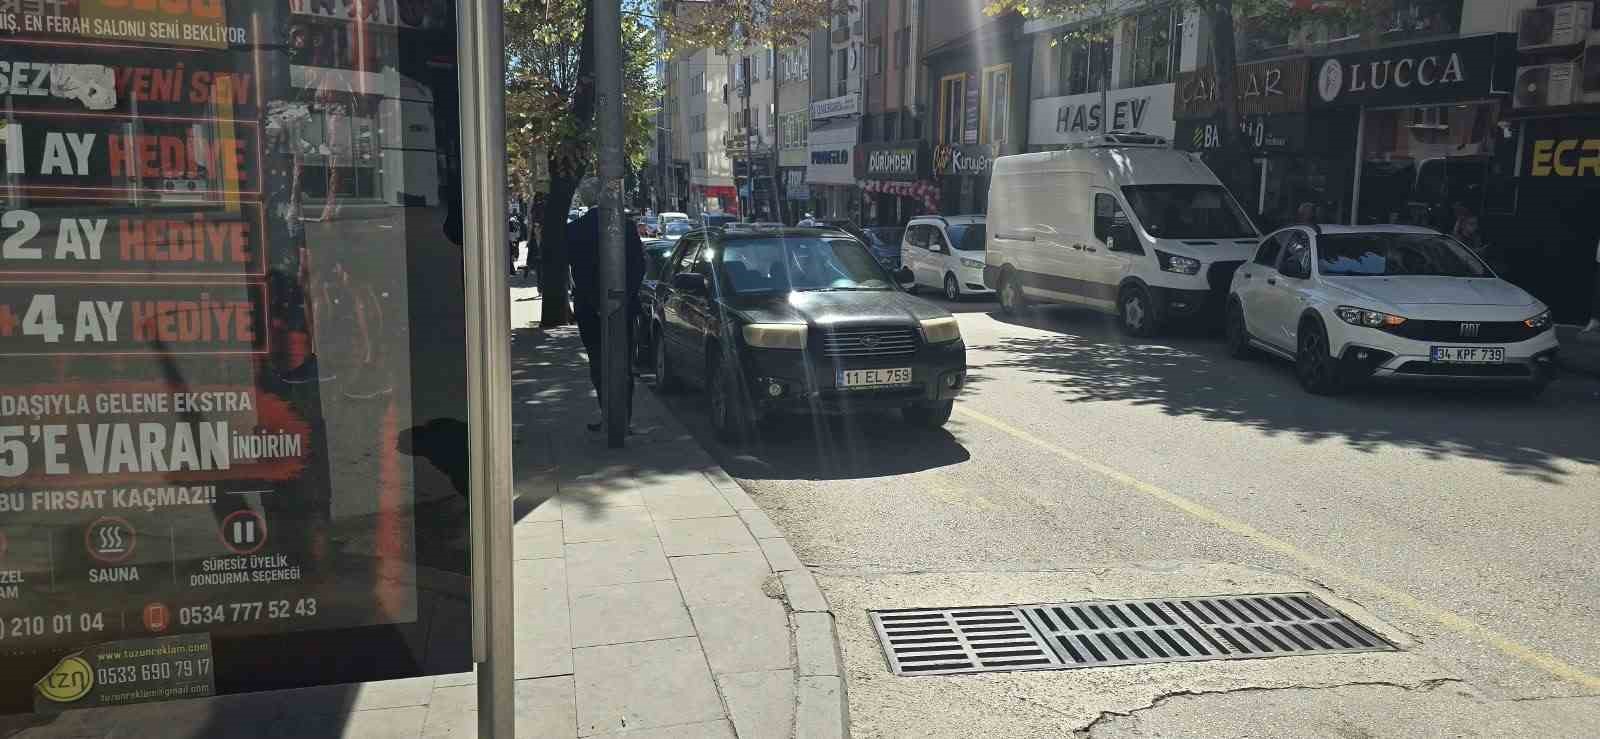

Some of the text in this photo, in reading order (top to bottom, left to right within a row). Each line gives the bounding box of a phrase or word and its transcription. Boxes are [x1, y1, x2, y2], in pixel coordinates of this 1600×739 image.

[25, 15, 43, 32] EN
[46, 16, 90, 34] FERAH
[94, 19, 146, 37] SALONU
[150, 20, 180, 40] SENİ
[183, 23, 246, 44] BEKLİYOR
[114, 62, 184, 104] YENİ
[1349, 52, 1464, 93] LUCCA
[1056, 99, 1148, 133] HAS EV
[40, 132, 97, 176] AY
[108, 127, 248, 181] HEDİYE
[0, 210, 251, 262] 2 AY HEDİYE
[74, 301, 124, 342] AY
[131, 292, 256, 342] HEDİYE
[1438, 348, 1501, 361] 34 KPF 739
[846, 369, 910, 385] 11 EL 759
[0, 390, 252, 420] DAŞIYLA GELENE EKSTRA
[77, 420, 231, 475] VARAN
[232, 429, 302, 459] İNDİRİM
[0, 485, 217, 511] BU FIRSAT KAÇMAZ!!
[89, 567, 139, 583] SAUNA
[190, 566, 301, 586] DONDURMA SEÇENEĞİ
[202, 554, 288, 572] SÜRESİZ ÜYELİK
[11, 615, 45, 637] 210
[53, 614, 72, 635] 01
[80, 612, 105, 632] 04
[180, 598, 317, 625] 0534 777 52 43
[98, 658, 210, 685] 0533 690 79 17
